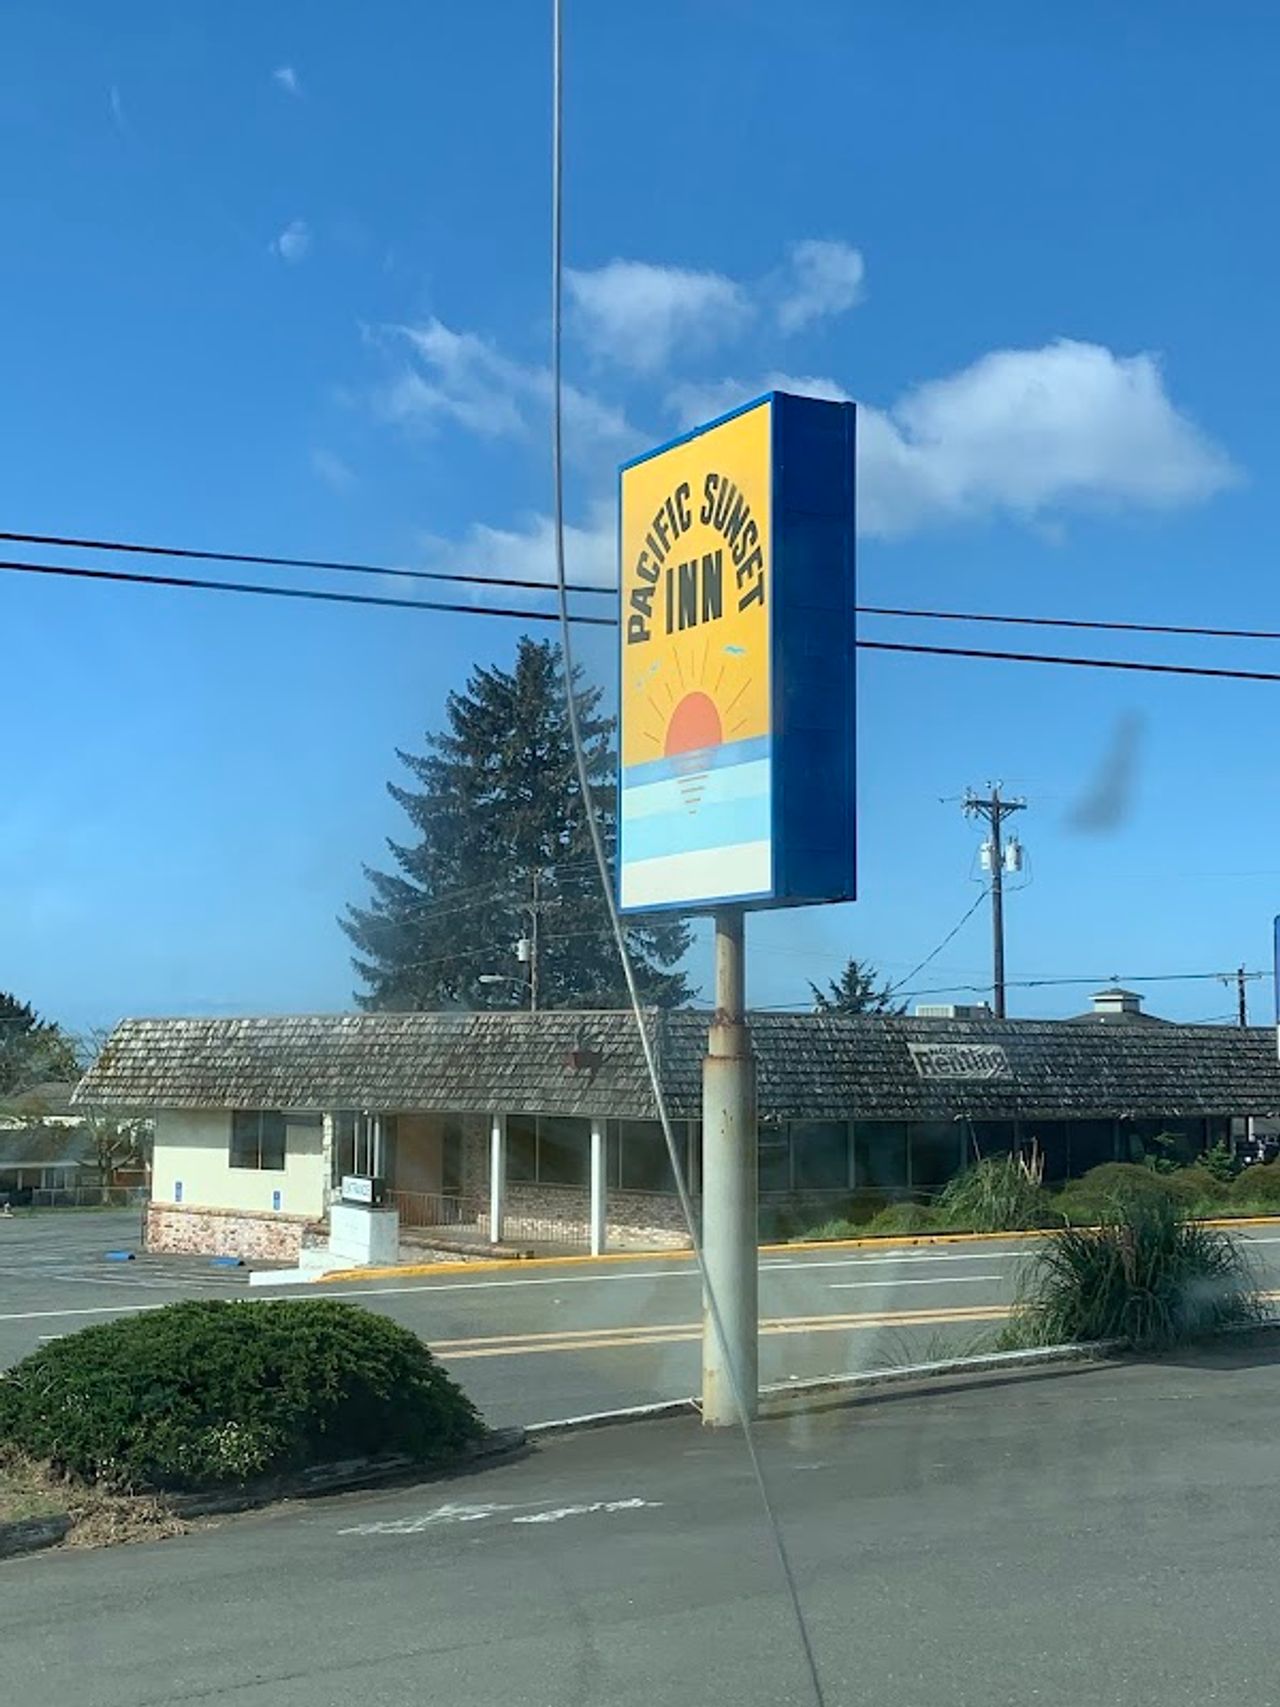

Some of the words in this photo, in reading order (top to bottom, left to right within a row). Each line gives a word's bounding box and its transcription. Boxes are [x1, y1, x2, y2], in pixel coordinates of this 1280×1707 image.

[627, 481, 692, 645] PACIFIC
[699, 472, 765, 613] SUNSET
[665, 548, 723, 635] INN
